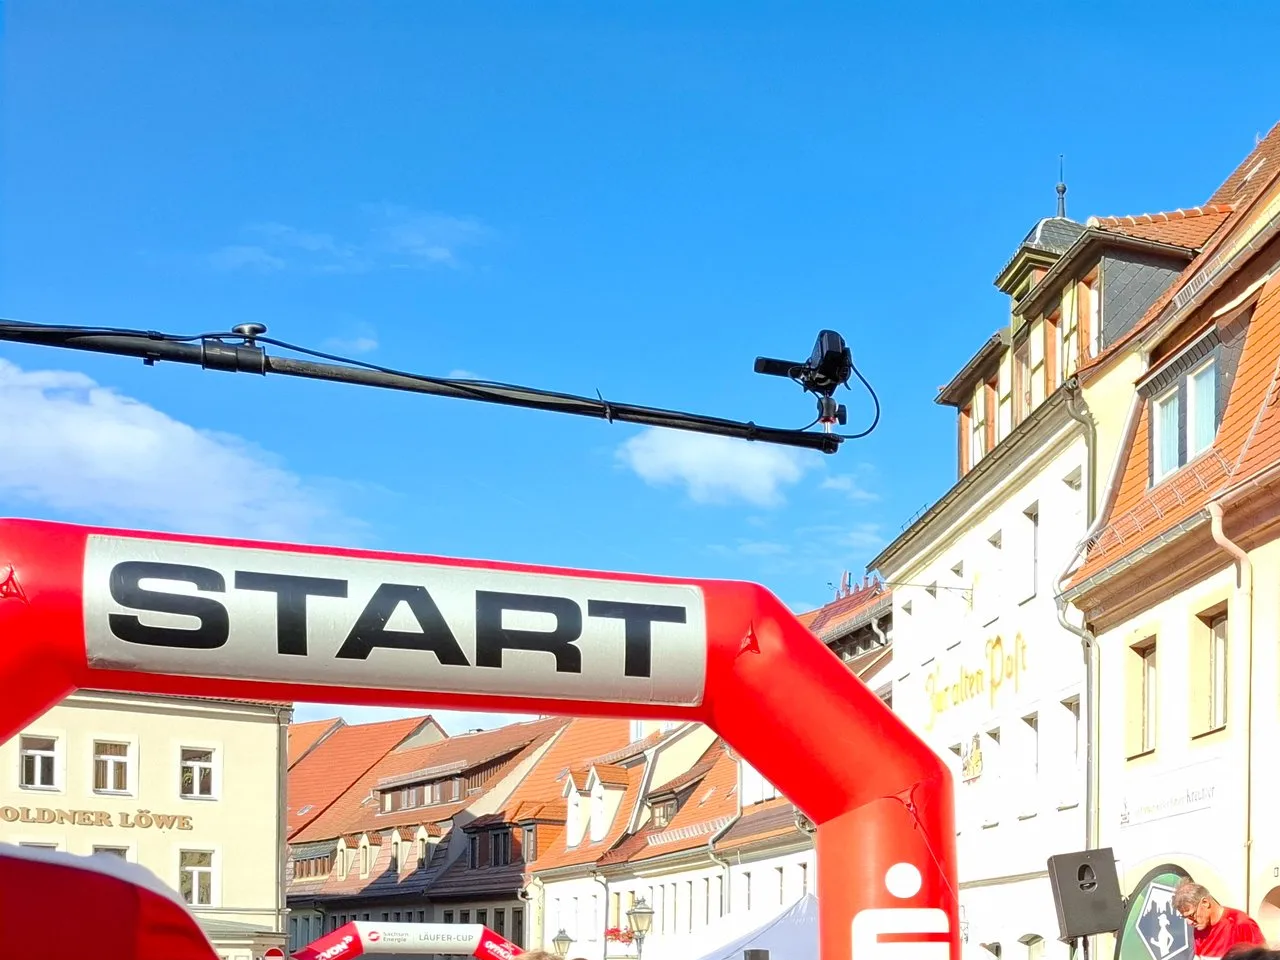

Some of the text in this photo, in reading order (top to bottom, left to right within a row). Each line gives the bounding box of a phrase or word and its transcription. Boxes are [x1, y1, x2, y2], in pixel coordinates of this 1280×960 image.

[108, 561, 686, 678] START
[0, 805, 193, 830] OLDNER LÖWE
[418, 932, 474, 943] LÄUFER-CUP
